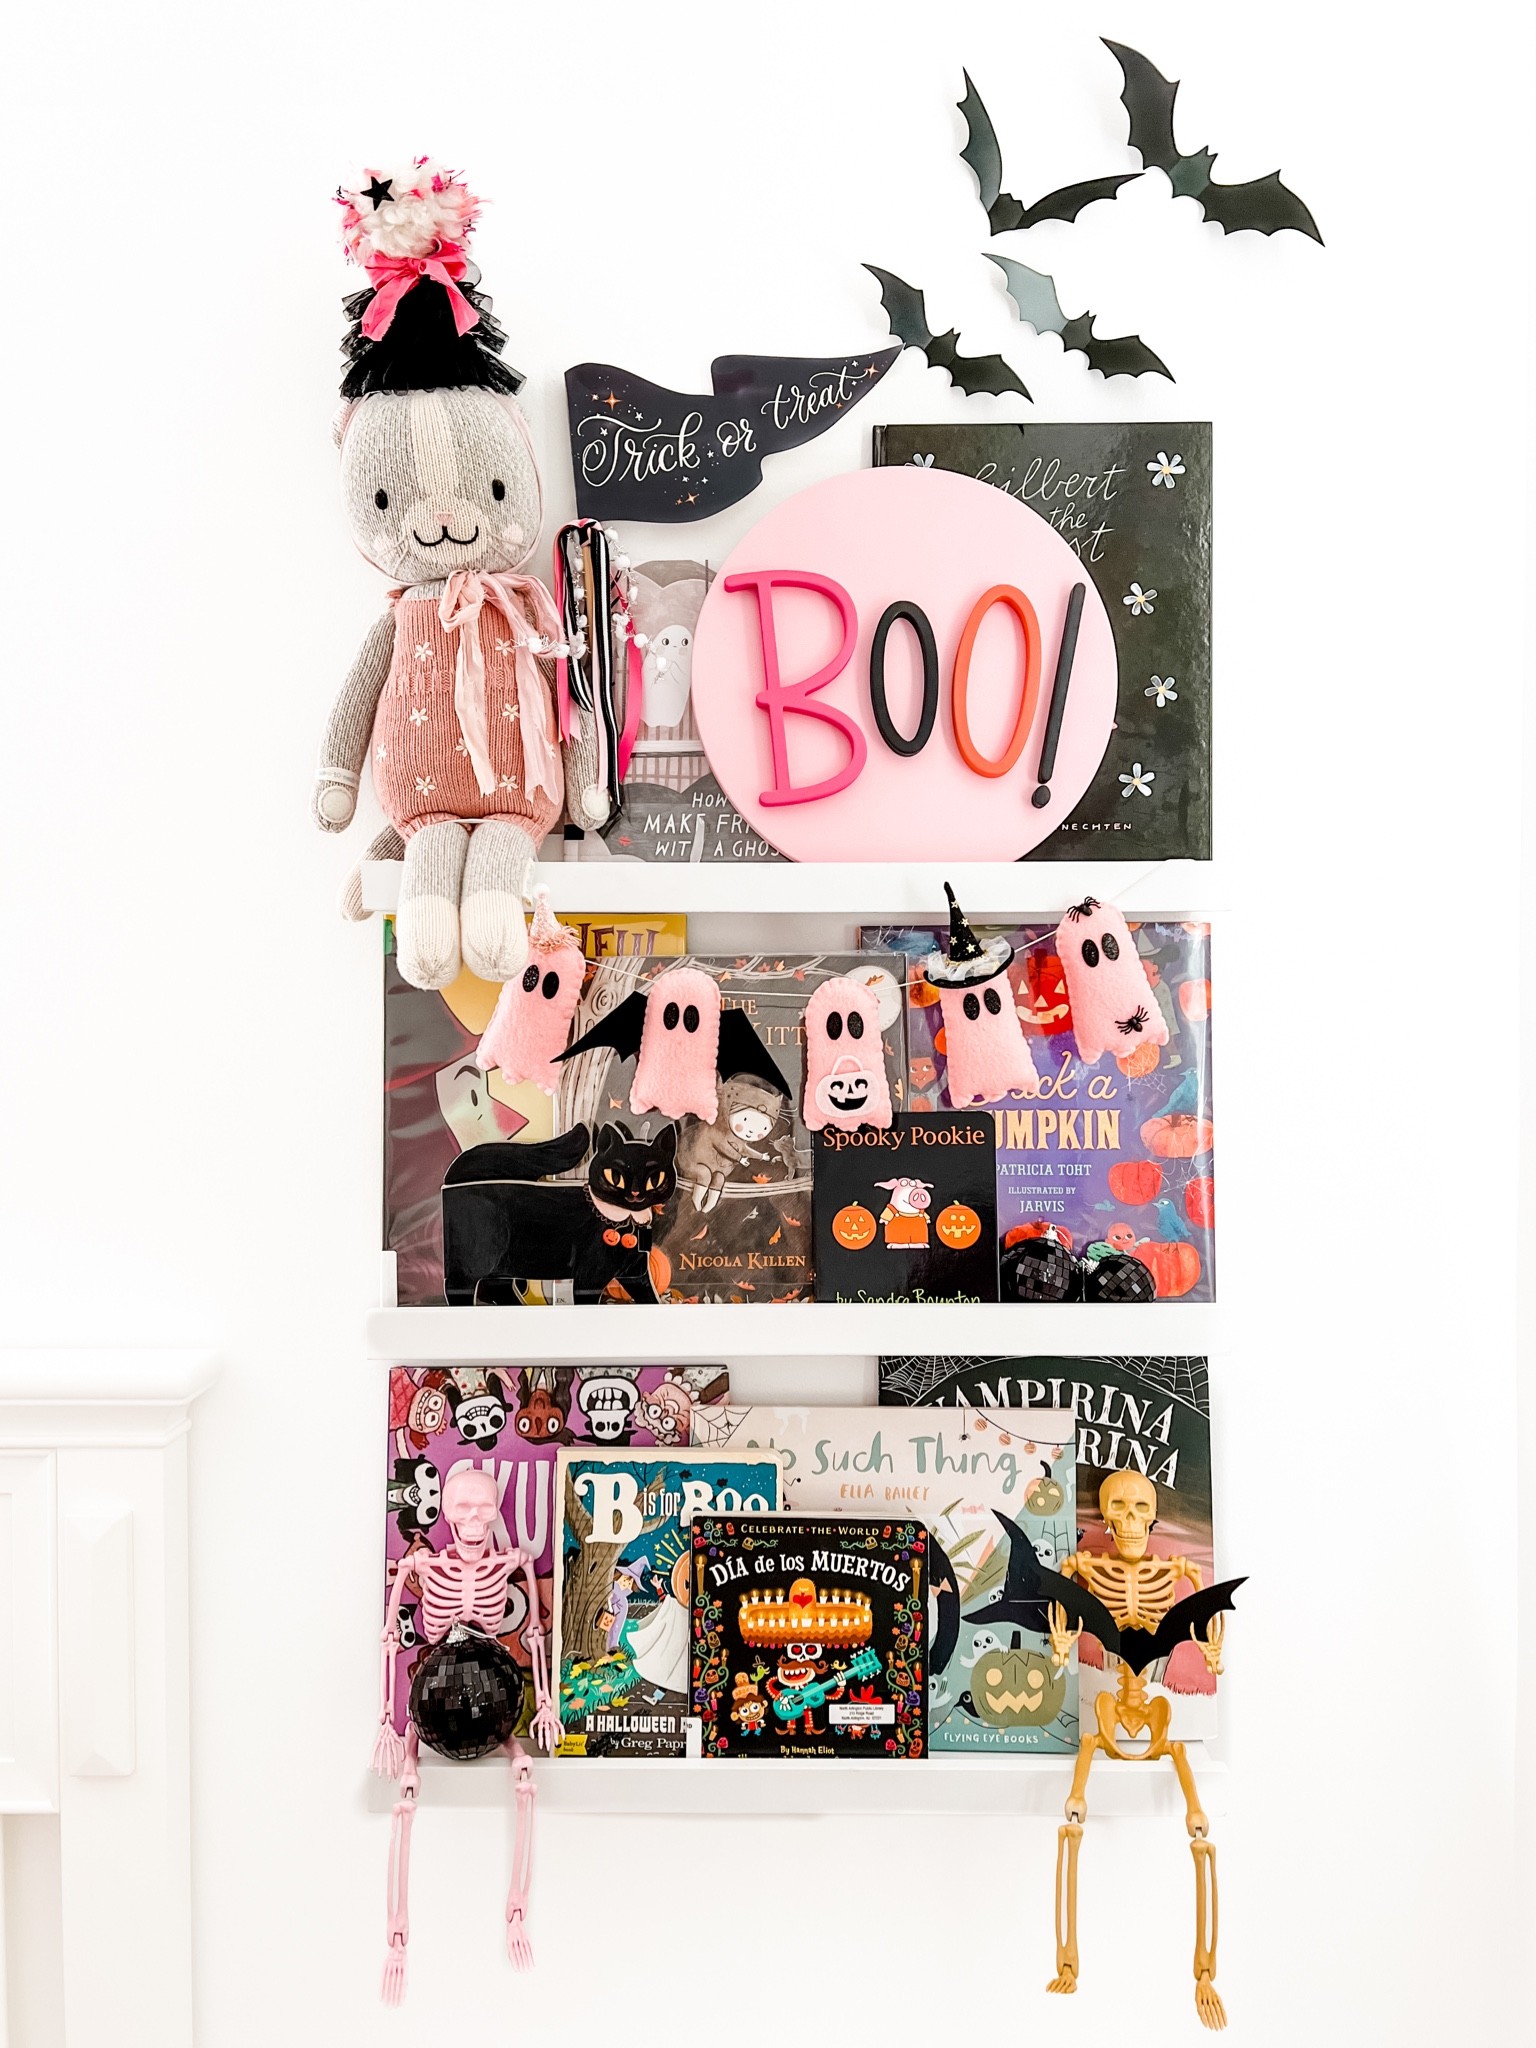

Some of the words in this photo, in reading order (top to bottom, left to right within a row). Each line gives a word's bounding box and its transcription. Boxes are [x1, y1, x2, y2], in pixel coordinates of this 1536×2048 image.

[577, 412, 703, 487] Trick
[717, 418, 756, 457] or
[760, 365, 868, 430] treat
[1050, 502, 1088, 531] the
[724, 569, 1087, 809] BOO!
[691, 792, 728, 808] HOW
[1061, 823, 1132, 831] NECHTEN
[655, 840, 692, 857] WIT
[714, 840, 724, 857] A
[720, 997, 758, 1015] THE
[1087, 1075, 1118, 1100] a
[823, 1127, 905, 1151] Spooky
[910, 1126, 985, 1146] Pookie
[996, 1164, 1053, 1176] PATRICIA
[1058, 1164, 1092, 1176] TOHT
[1008, 1187, 1063, 1195] ILLUSTRATED
[1066, 1187, 1076, 1195] BY
[1020, 1201, 1065, 1213] JARVIS
[812, 1430, 893, 1475] Such
[908, 1431, 1022, 1494] Thing
[840, 1483, 875, 1499] ELLA
[885, 1486, 930, 1501] BAILEY
[574, 1472, 643, 1544] B
[643, 1487, 656, 1516] is
[660, 1488, 681, 1516] for
[741, 1524, 804, 1534] CELEBRATE
[812, 1526, 832, 1535] THE
[838, 1526, 879, 1536] WORLD
[709, 1554, 750, 1587] DÍA
[754, 1555, 775, 1574] de
[779, 1553, 805, 1572] los
[811, 1549, 911, 1593] MUERTOS
[585, 1715, 594, 1732] A
[597, 1715, 675, 1733] HALLOWEEN
[610, 1737, 619, 1749] by
[621, 1737, 653, 1750] Greg
[657, 1737, 687, 1750] Papr
[944, 1732, 979, 1743] FLYING
[983, 1734, 1000, 1743] EYE
[1004, 1734, 1039, 1744] BOOKS
[780, 1745, 790, 1755] By
[818, 1746, 835, 1755] Eliot
